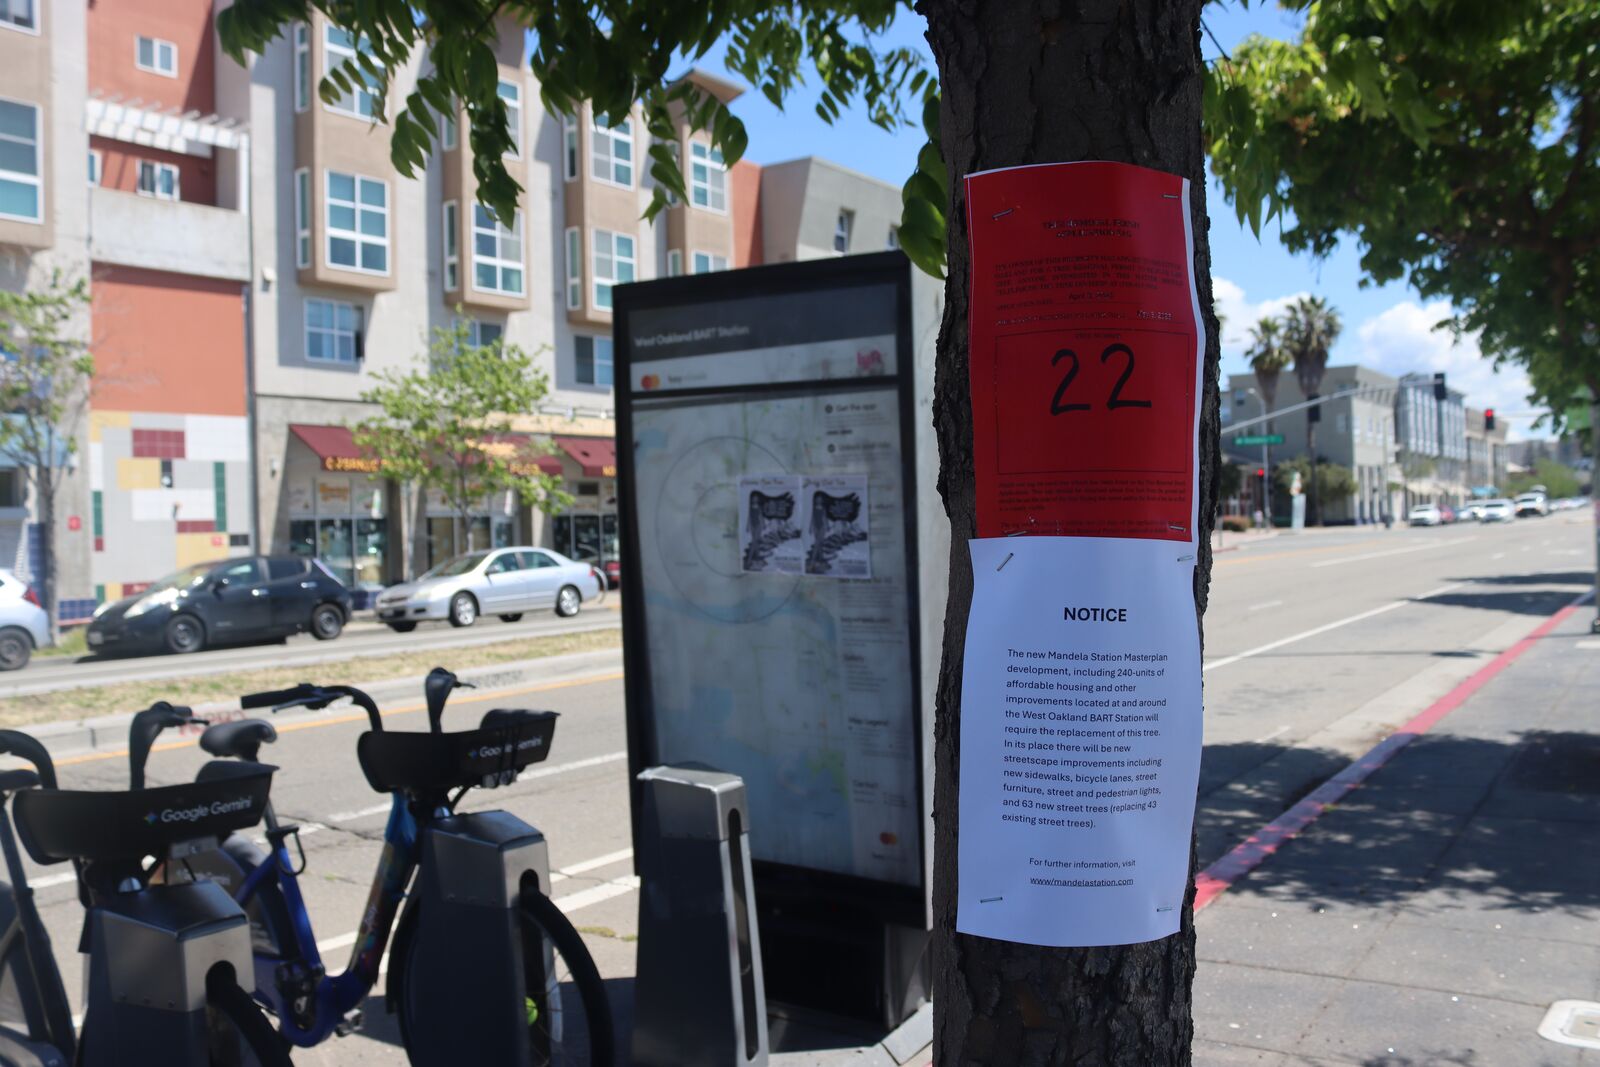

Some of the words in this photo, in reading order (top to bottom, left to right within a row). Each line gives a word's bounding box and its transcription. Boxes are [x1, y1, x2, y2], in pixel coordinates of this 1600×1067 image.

[1064, 607, 1128, 622] NOTICE
[1008, 649, 1025, 658] The
[1048, 652, 1089, 661] Mandela
[1090, 653, 1123, 662] Station
[1124, 653, 1168, 663] Masterplan
[1007, 665, 1071, 676] development,
[1073, 668, 1116, 678] including
[1117, 668, 1155, 677] 240-units
[1006, 680, 1055, 690] affordable
[1056, 683, 1094, 693] housing
[1095, 683, 1113, 692] and
[1114, 684, 1136, 692] other
[1006, 695, 1073, 707] improvements
[1074, 698, 1110, 707] located
[1111, 699, 1120, 707] at
[1121, 699, 1138, 707] and
[1138, 698, 1166, 706] around
[1005, 710, 1020, 718] the
[1022, 711, 1047, 720] West
[1048, 712, 1088, 722] Oakland
[1089, 714, 1114, 722] BART
[1114, 714, 1143, 722] Station
[1005, 725, 1038, 736] require
[1039, 727, 1055, 735] the
[1056, 728, 1116, 738] replacement
[1117, 729, 1125, 737] of
[1126, 729, 1142, 737] this
[1143, 728, 1160, 736] tree.
[479, 744, 513, 758] Goole
[1005, 740, 1013, 748] In
[1014, 741, 1027, 749] its
[1028, 742, 1055, 752] place
[1056, 743, 1081, 752] there
[1083, 744, 1100, 752] will
[1101, 744, 1112, 752] be
[1003, 755, 1059, 766] streetscape
[1060, 757, 1125, 768] improvements
[1126, 758, 1162, 767] including
[1024, 771, 1074, 782] sidewalks,
[1075, 773, 1108, 784] bicycle
[1109, 774, 1134, 783] lanes,
[1135, 773, 1157, 781] street
[1003, 784, 1045, 795] furniture,
[1047, 787, 1074, 796] street
[1076, 788, 1094, 797] and
[1095, 788, 1138, 798] pedestrian
[1139, 787, 1161, 796] lights,
[160, 804, 209, 822] Google
[210, 795, 253, 815] Gemini
[1002, 799, 1020, 807] and
[1021, 800, 1034, 808] 63
[1056, 803, 1083, 812] street
[1085, 804, 1109, 813] trees
[1110, 802, 1146, 813] (replacing
[1002, 813, 1037, 825] existing
[1038, 817, 1065, 826] street
[1067, 819, 1096, 828] trees).
[1029, 858, 1042, 867] For
[1045, 859, 1072, 868] further
[1074, 860, 1120, 868] information,
[1122, 859, 1135, 867] visit
